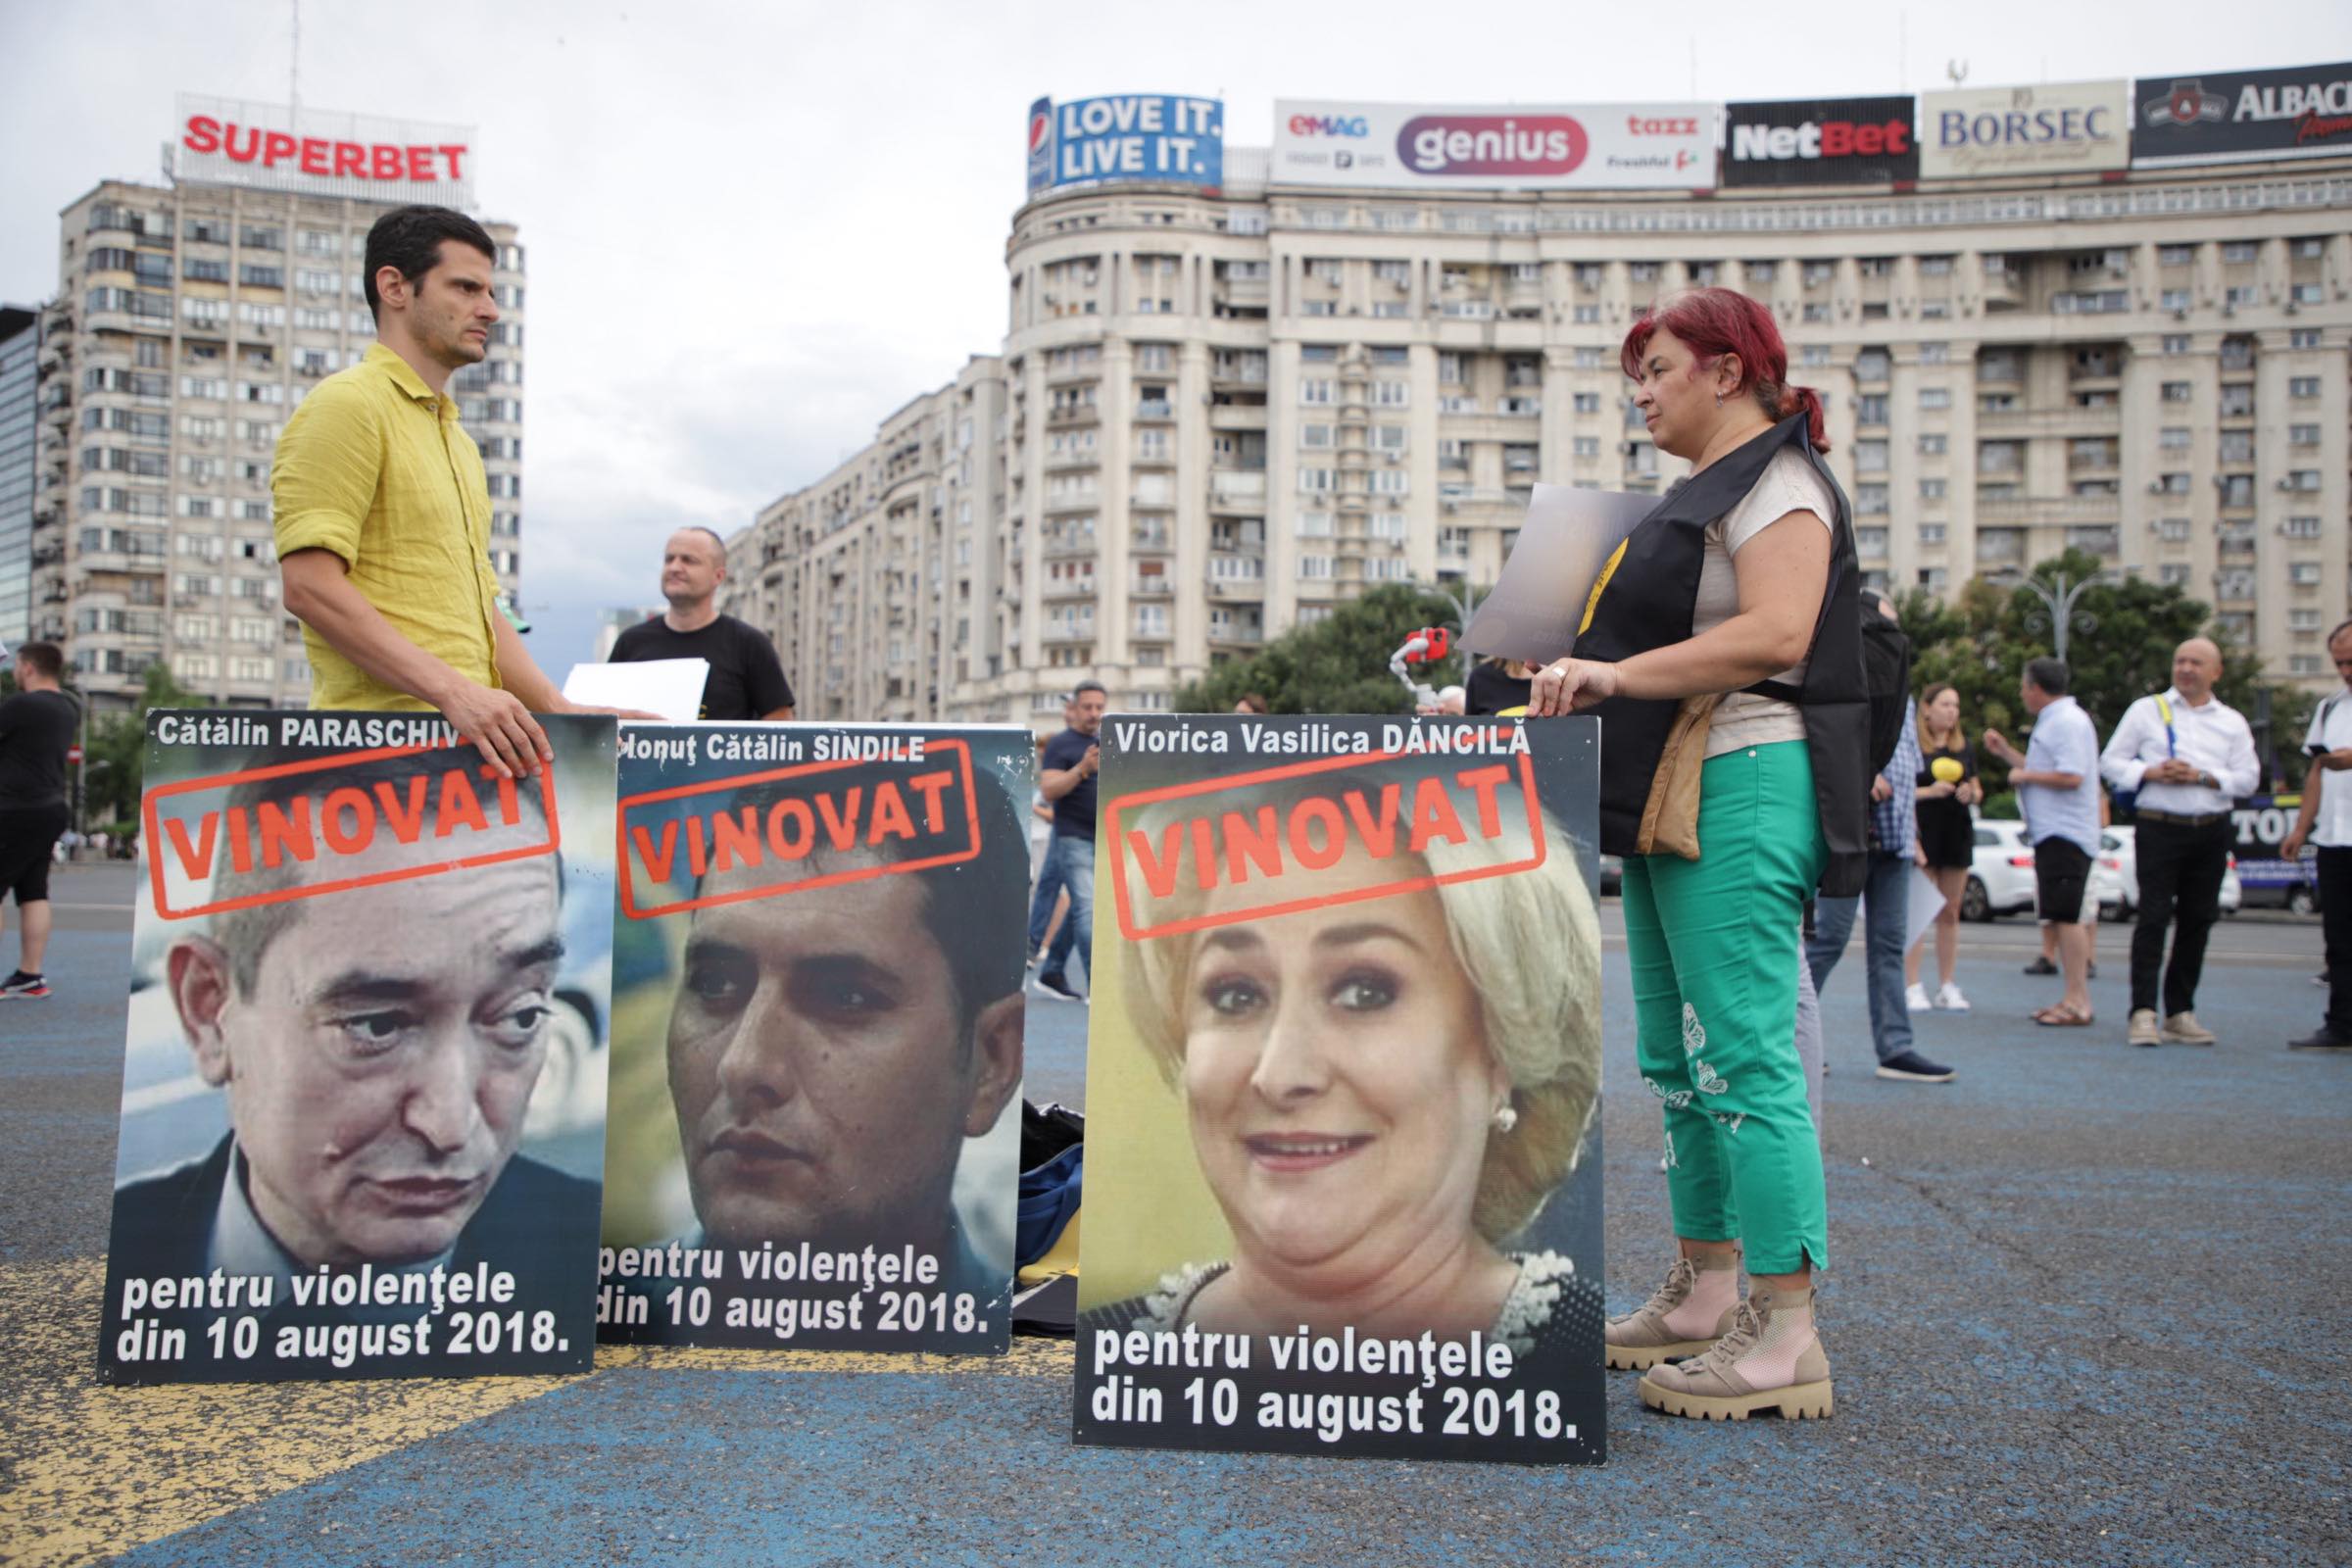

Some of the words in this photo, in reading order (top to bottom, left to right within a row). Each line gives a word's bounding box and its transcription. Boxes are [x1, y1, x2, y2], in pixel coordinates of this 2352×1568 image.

[1063, 99, 1163, 139] LOVE
[1176, 100, 1223, 136] IT.
[1733, 119, 1909, 161] NetBet
[1939, 105, 2110, 148] BORSEC
[183, 115, 467, 181] SUPERBET
[1063, 137, 1145, 178] LIVE
[1156, 138, 1205, 173] IT.
[1414, 120, 1570, 171] genius
[158, 715, 270, 746] Cătălin
[281, 717, 460, 749] PARASCHIV
[707, 733, 804, 761] Cătălin
[813, 734, 925, 762] SINDILE
[1114, 722, 1229, 753] Viorica
[1241, 722, 1370, 754] Vasilica
[1383, 716, 1532, 755] DĂNCILĂ
[163, 762, 520, 881] VINOVAT
[631, 770, 954, 884] VINOVAT
[1127, 764, 1511, 898] VINOVAT
[598, 1240, 723, 1286] pentru
[121, 1266, 273, 1320] pentru
[596, 1285, 649, 1325] din
[665, 1286, 711, 1327] 10
[725, 1290, 863, 1339] august
[877, 1291, 988, 1334] 2018.
[117, 1318, 186, 1362] din
[207, 1315, 260, 1360] 10
[274, 1314, 432, 1368] august
[447, 1310, 569, 1354] 2018.
[1094, 1321, 1250, 1375] pentru
[1092, 1374, 1163, 1423] din
[1183, 1377, 1239, 1427] 10
[1256, 1386, 1424, 1444] august
[1442, 1386, 1578, 1440] 2018.
